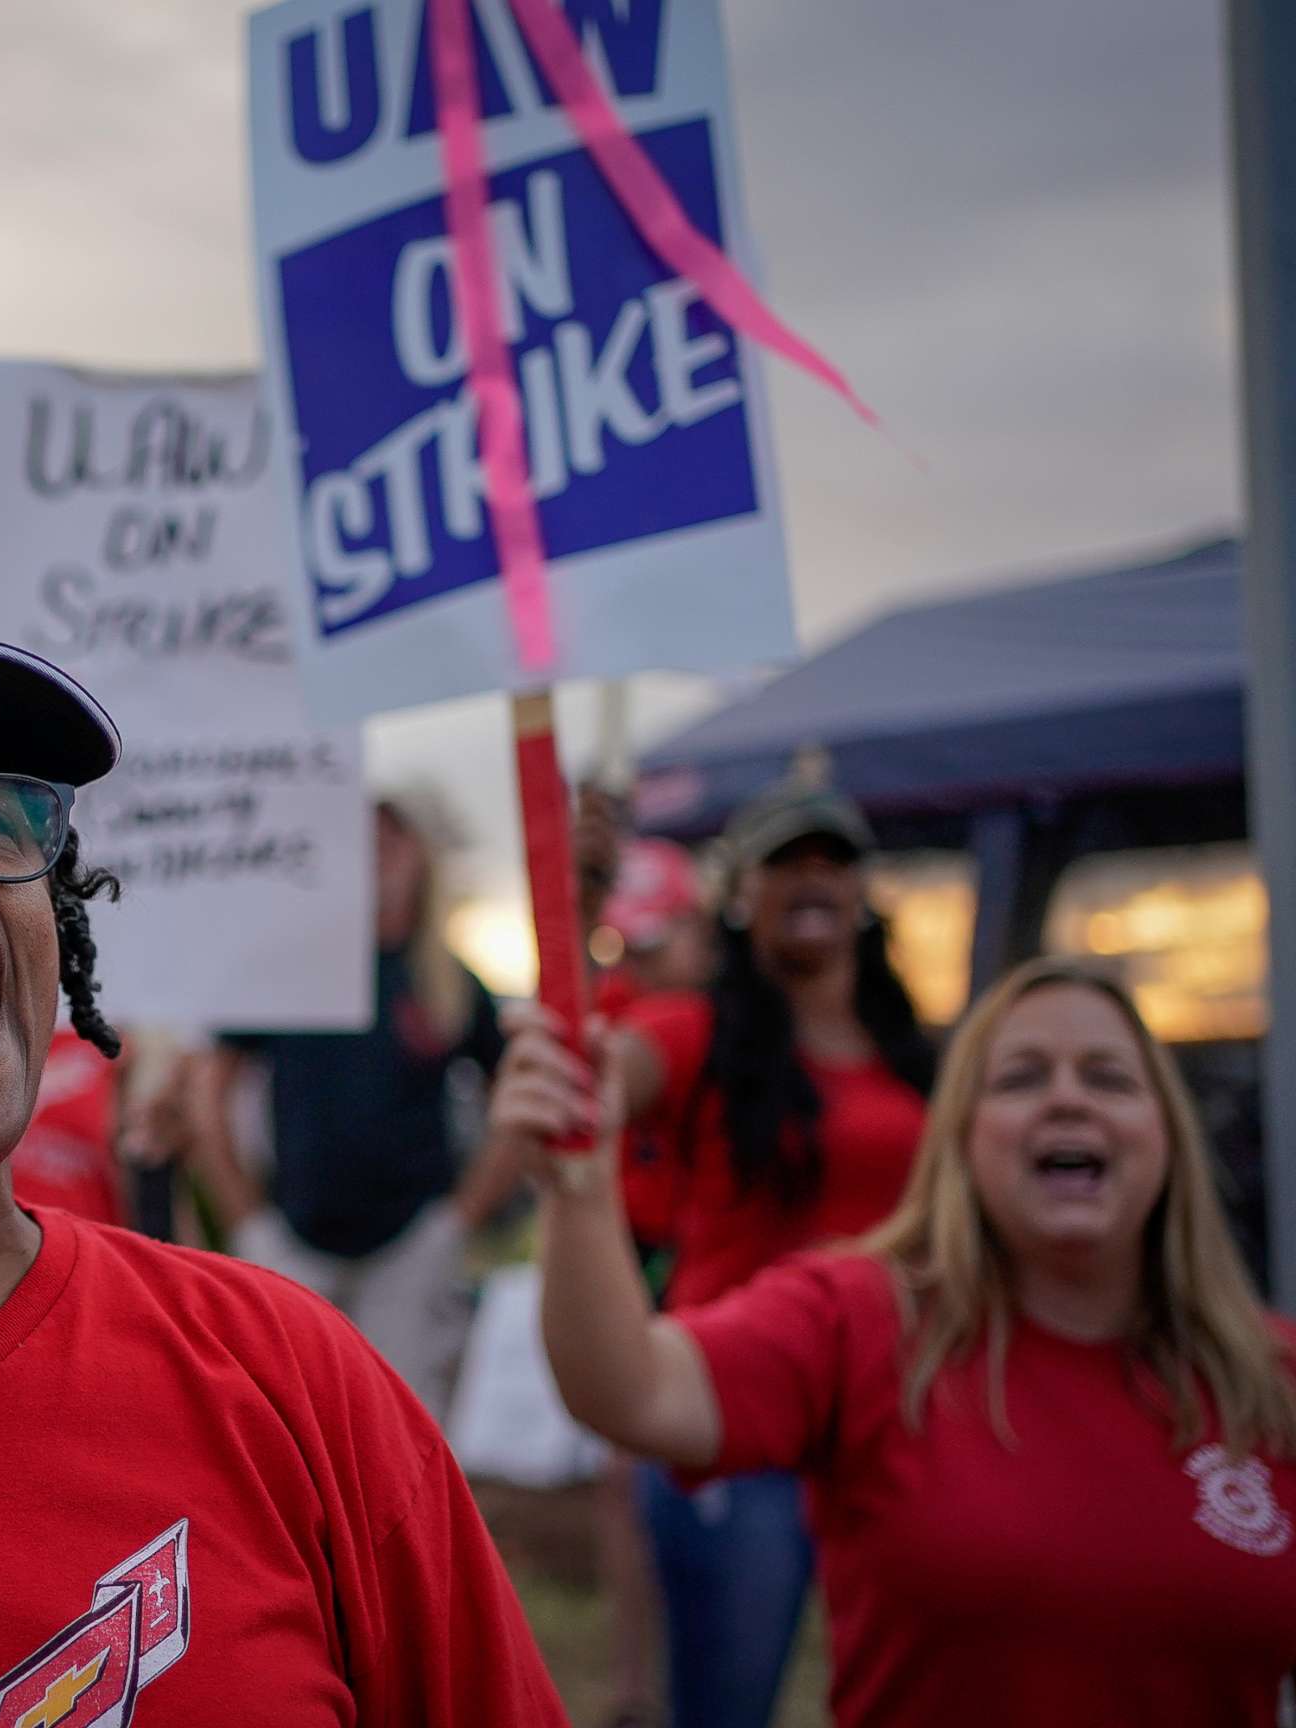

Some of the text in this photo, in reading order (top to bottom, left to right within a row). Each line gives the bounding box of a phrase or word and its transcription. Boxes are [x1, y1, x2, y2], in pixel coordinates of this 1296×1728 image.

[392, 168, 572, 388] ON
[25, 391, 274, 498] UAW
[103, 503, 218, 572] ON
